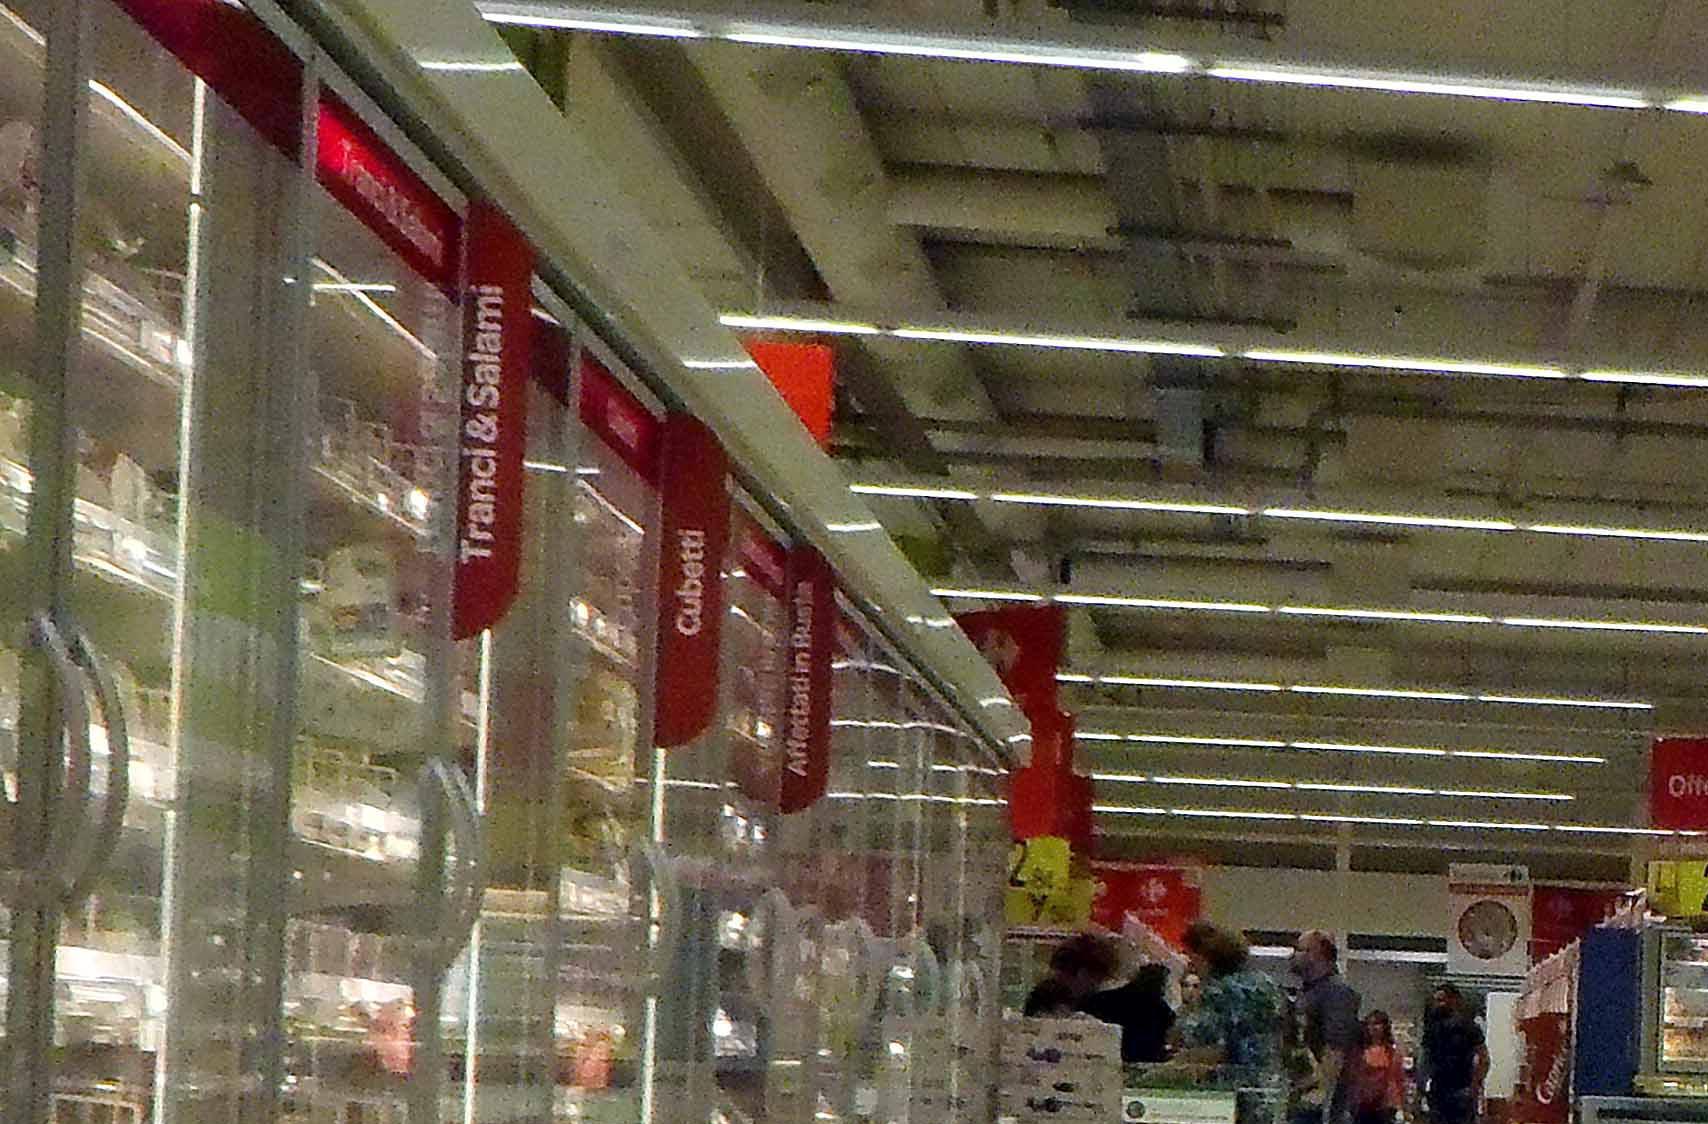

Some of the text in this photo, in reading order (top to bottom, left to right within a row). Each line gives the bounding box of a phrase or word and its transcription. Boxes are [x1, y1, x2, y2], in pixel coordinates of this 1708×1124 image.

[460, 285, 504, 565] Tranci & Salami
[674, 528, 705, 636] Cubetti
